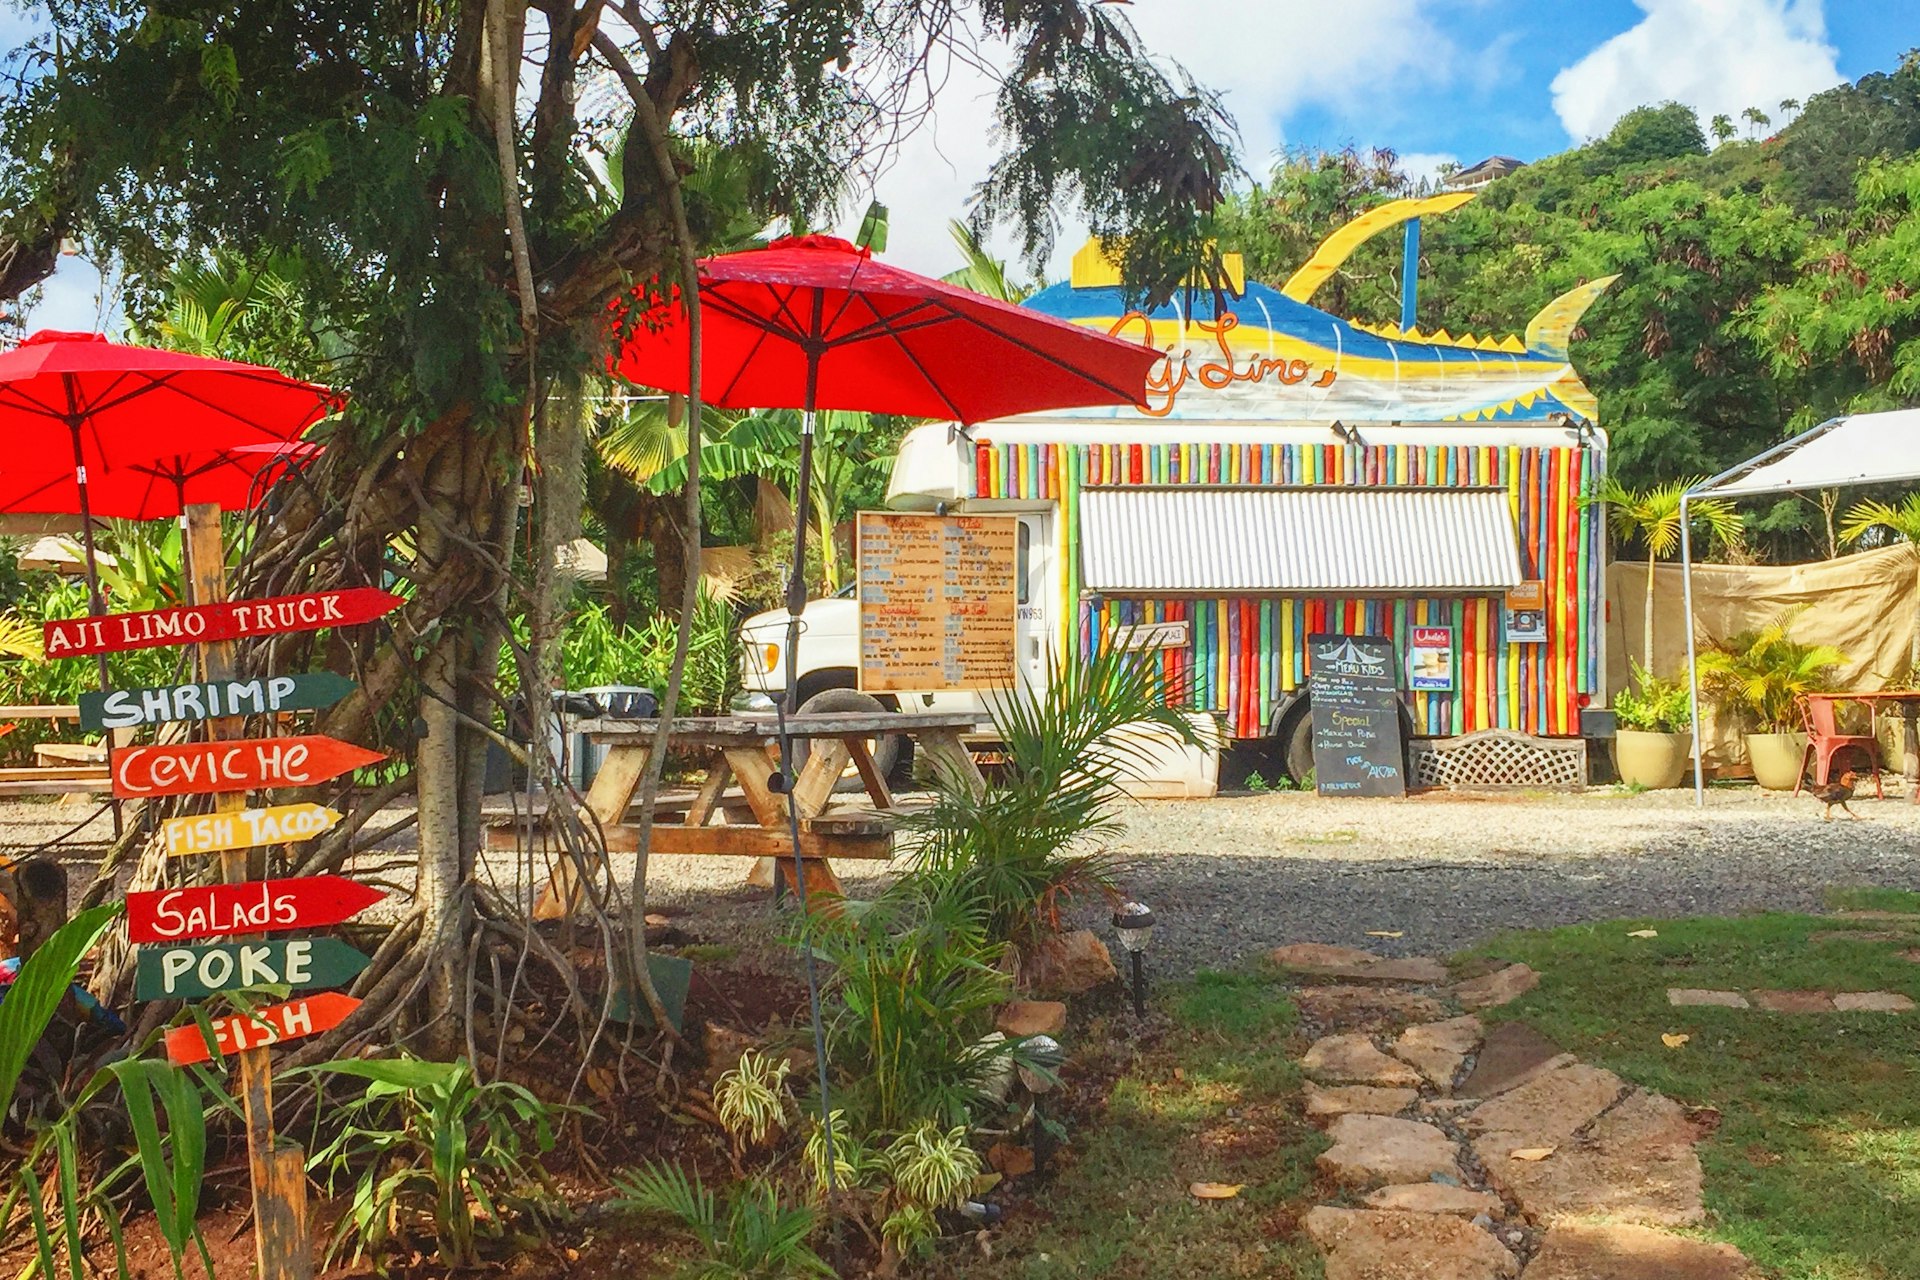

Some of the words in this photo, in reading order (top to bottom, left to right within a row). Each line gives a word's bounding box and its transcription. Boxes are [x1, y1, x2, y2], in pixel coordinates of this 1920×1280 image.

[1195, 312, 1313, 389] Limo
[48, 621, 106, 654] AJI
[119, 611, 206, 643] LIMO
[232, 595, 344, 632] TRUCK
[101, 676, 296, 728] SHRIMP
[167, 818, 233, 852] FISH
[240, 807, 328, 846] TACOS
[162, 940, 313, 994] POKE
